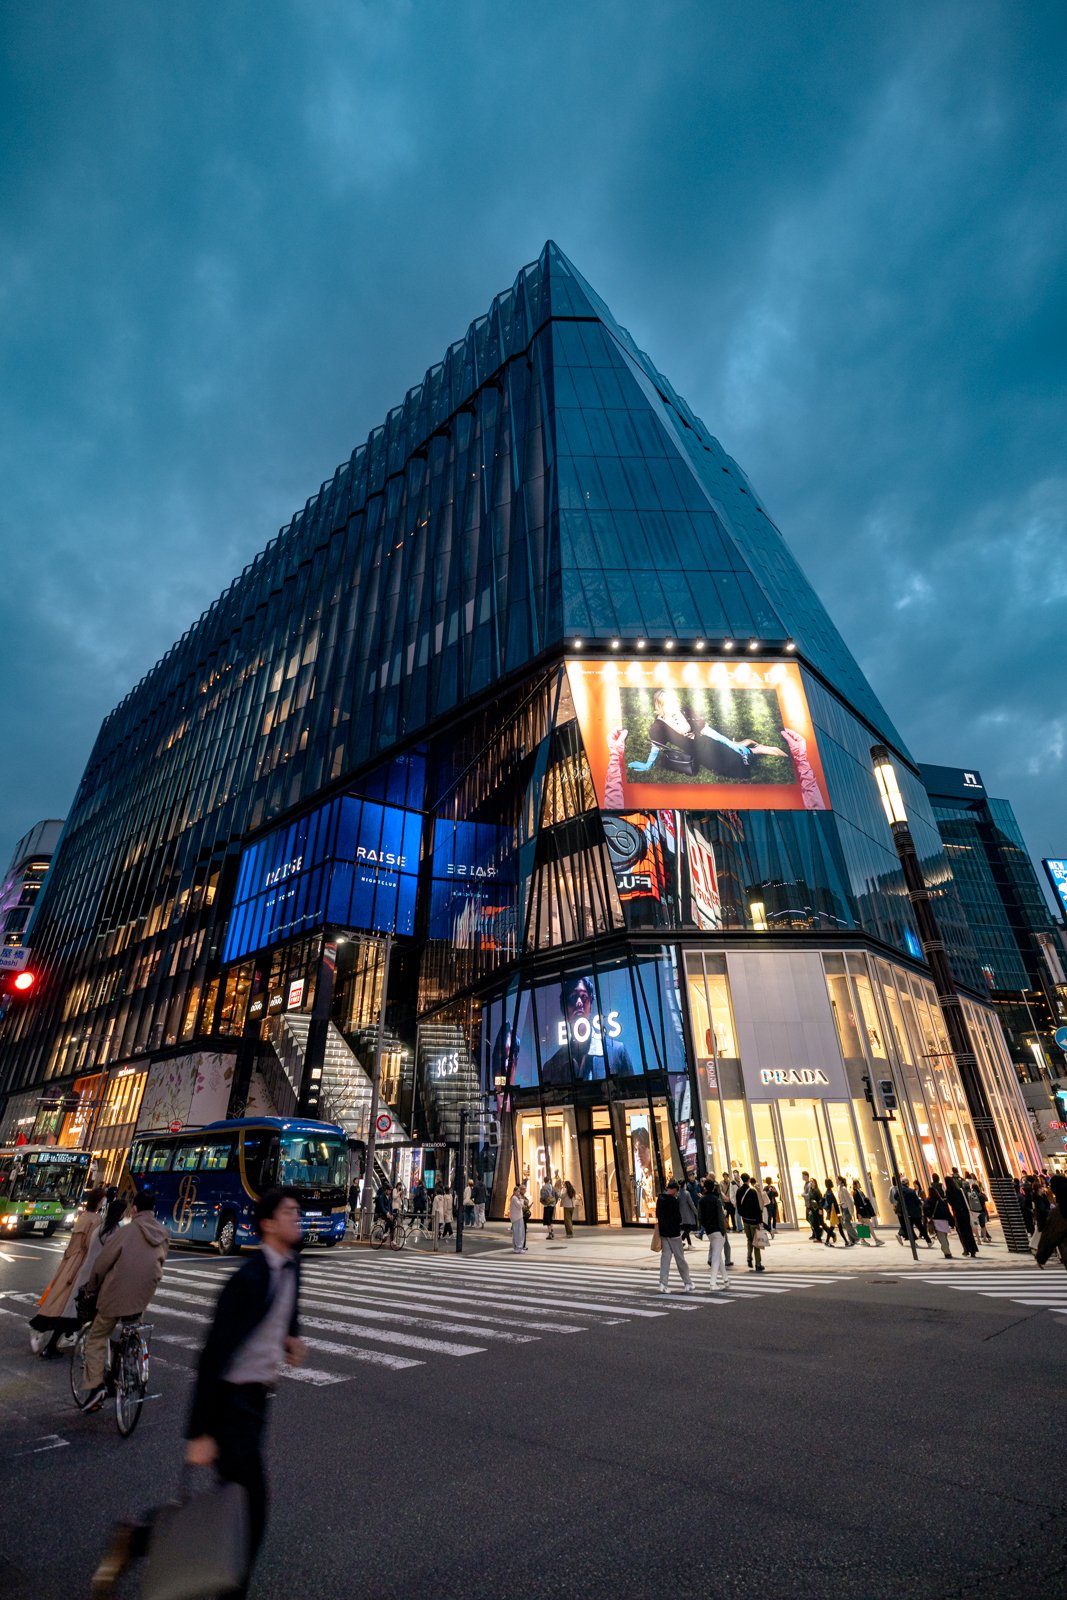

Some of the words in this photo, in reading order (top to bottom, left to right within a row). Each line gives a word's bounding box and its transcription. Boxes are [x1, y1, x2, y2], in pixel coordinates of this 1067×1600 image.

[357, 847, 406, 867] RAISE
[361, 877, 397, 888] NIGHTCLUB
[558, 1011, 622, 1045] BOSS
[760, 1068, 830, 1085] PRADA
